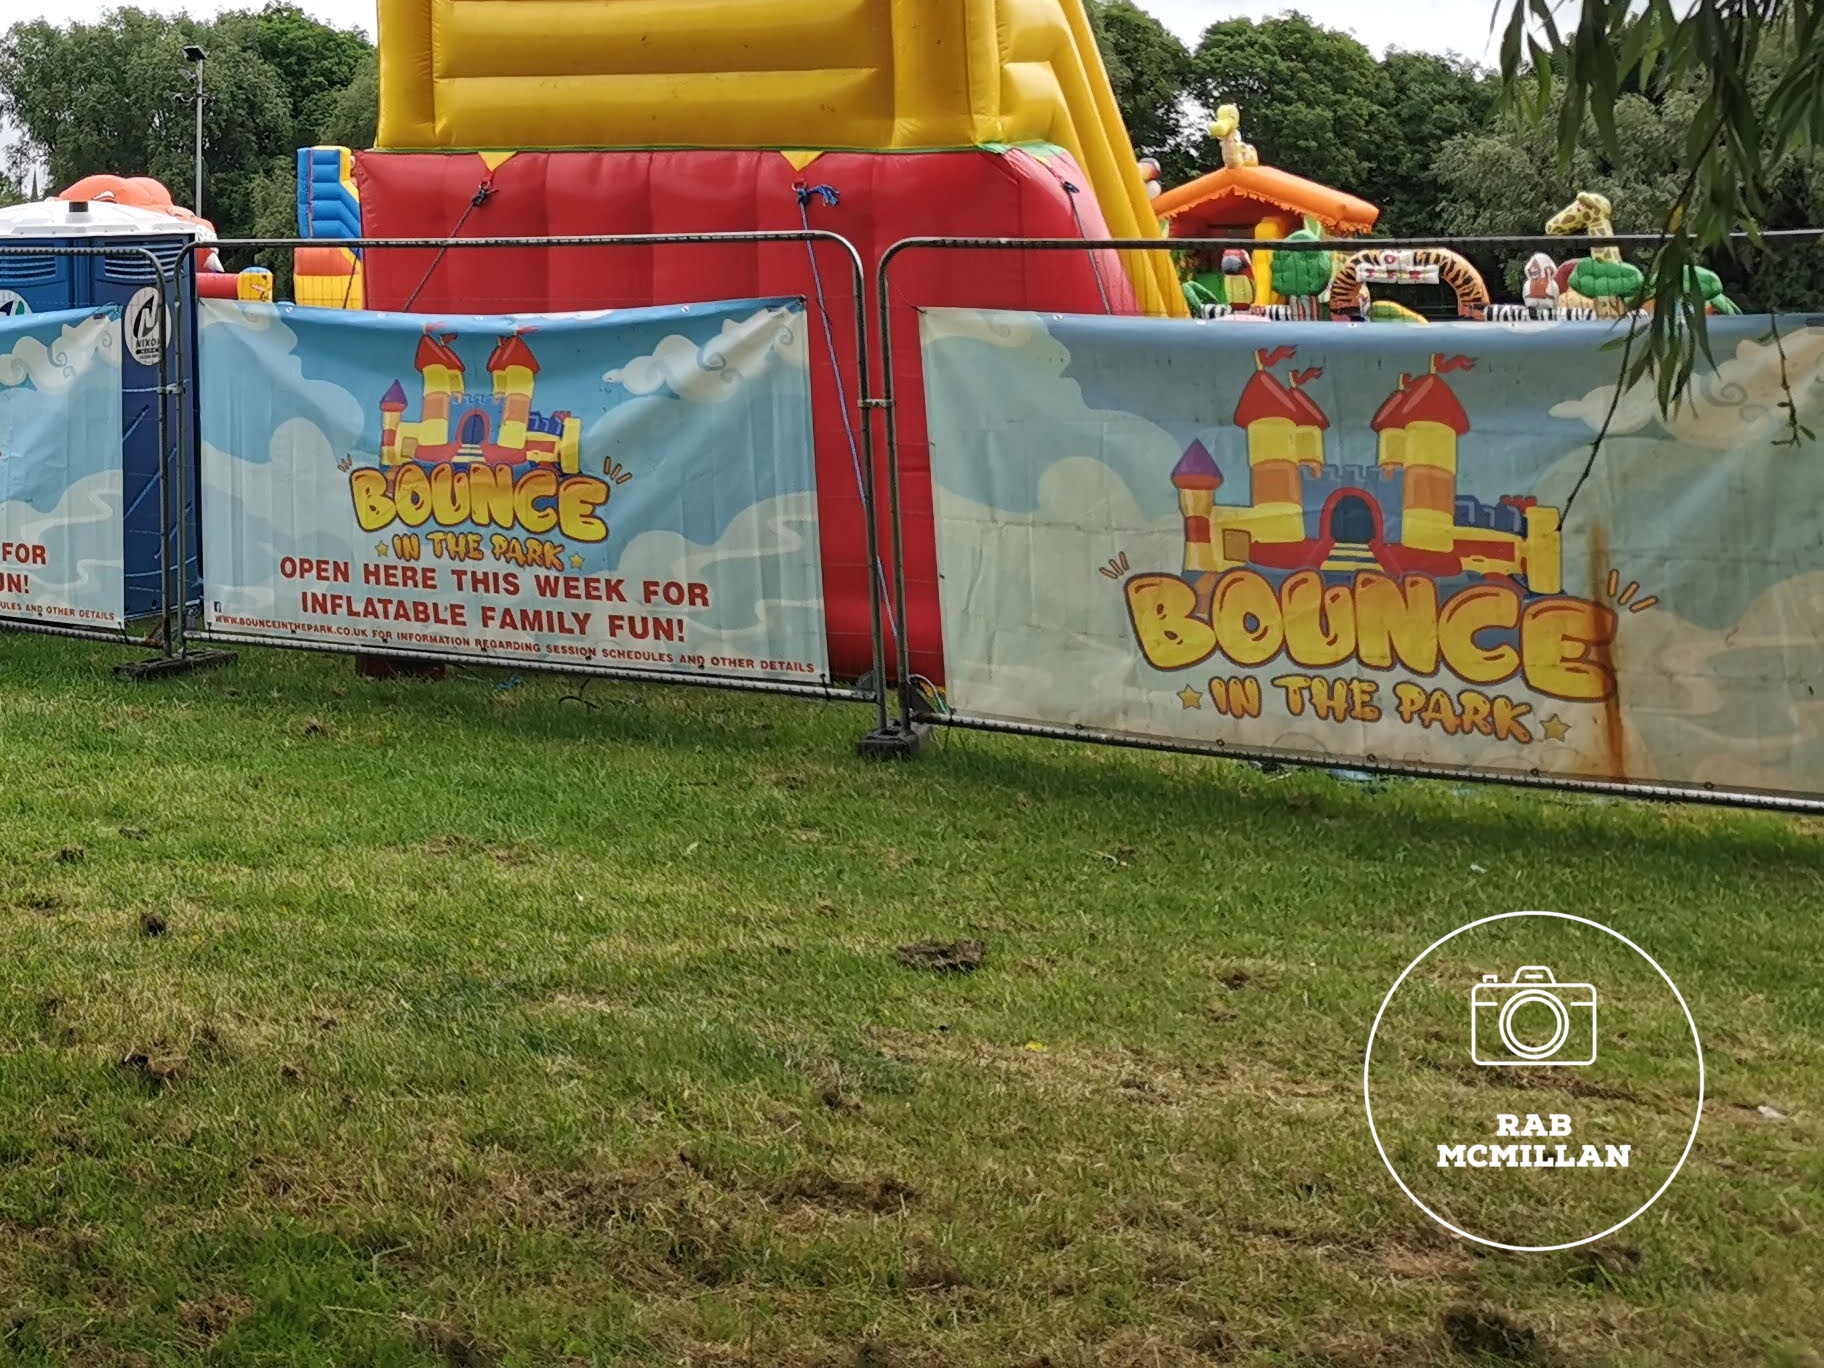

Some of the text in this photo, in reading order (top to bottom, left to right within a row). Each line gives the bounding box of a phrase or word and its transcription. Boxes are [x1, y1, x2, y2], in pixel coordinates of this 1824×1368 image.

[349, 461, 610, 544] BOUNCE
[2, 542, 47, 565] FOR
[392, 530, 565, 572] IN THE PARK
[280, 556, 710, 608] OPEN HERE THIS WEEK FOR
[26, 604, 43, 613] AND
[46, 605, 76, 617] OTHER
[79, 609, 115, 621] DETAILS
[301, 591, 686, 643] INFLATABLE FAMILY FUN!
[1124, 567, 1618, 703] BOUNCE
[214, 614, 815, 674] WWW.BOUNCEINTHEPARK.CO.UK FOR INFORMATION REGARDING SESSION SCHEDULES AND OTHER DETAILS
[1208, 674, 1534, 745] IN THE PARK
